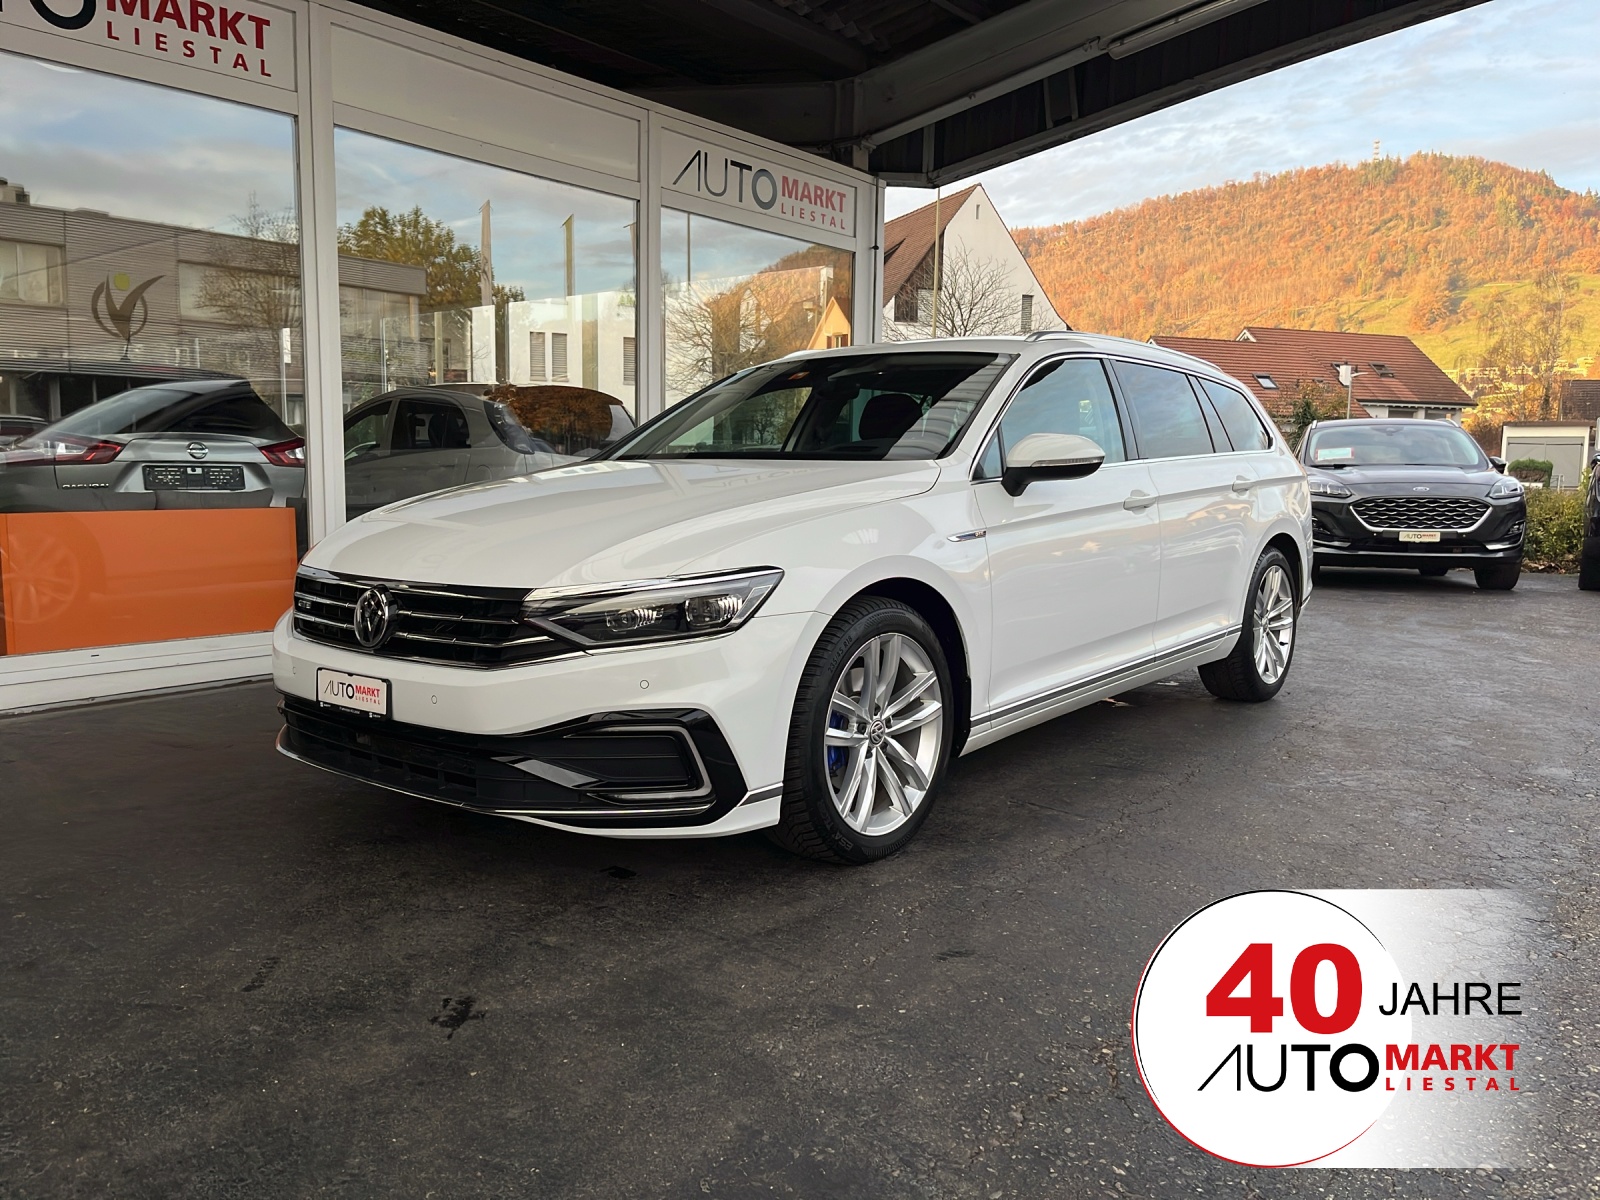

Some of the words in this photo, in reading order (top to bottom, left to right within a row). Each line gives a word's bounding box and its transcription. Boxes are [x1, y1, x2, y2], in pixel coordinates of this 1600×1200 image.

[107, 21, 271, 77] LIESTAL
[782, 175, 847, 213] MARKT
[781, 202, 846, 230] LIESTAL
[324, 679, 355, 700] AUTO
[355, 684, 381, 698] MARKT
[355, 696, 381, 706] LIESTAL
